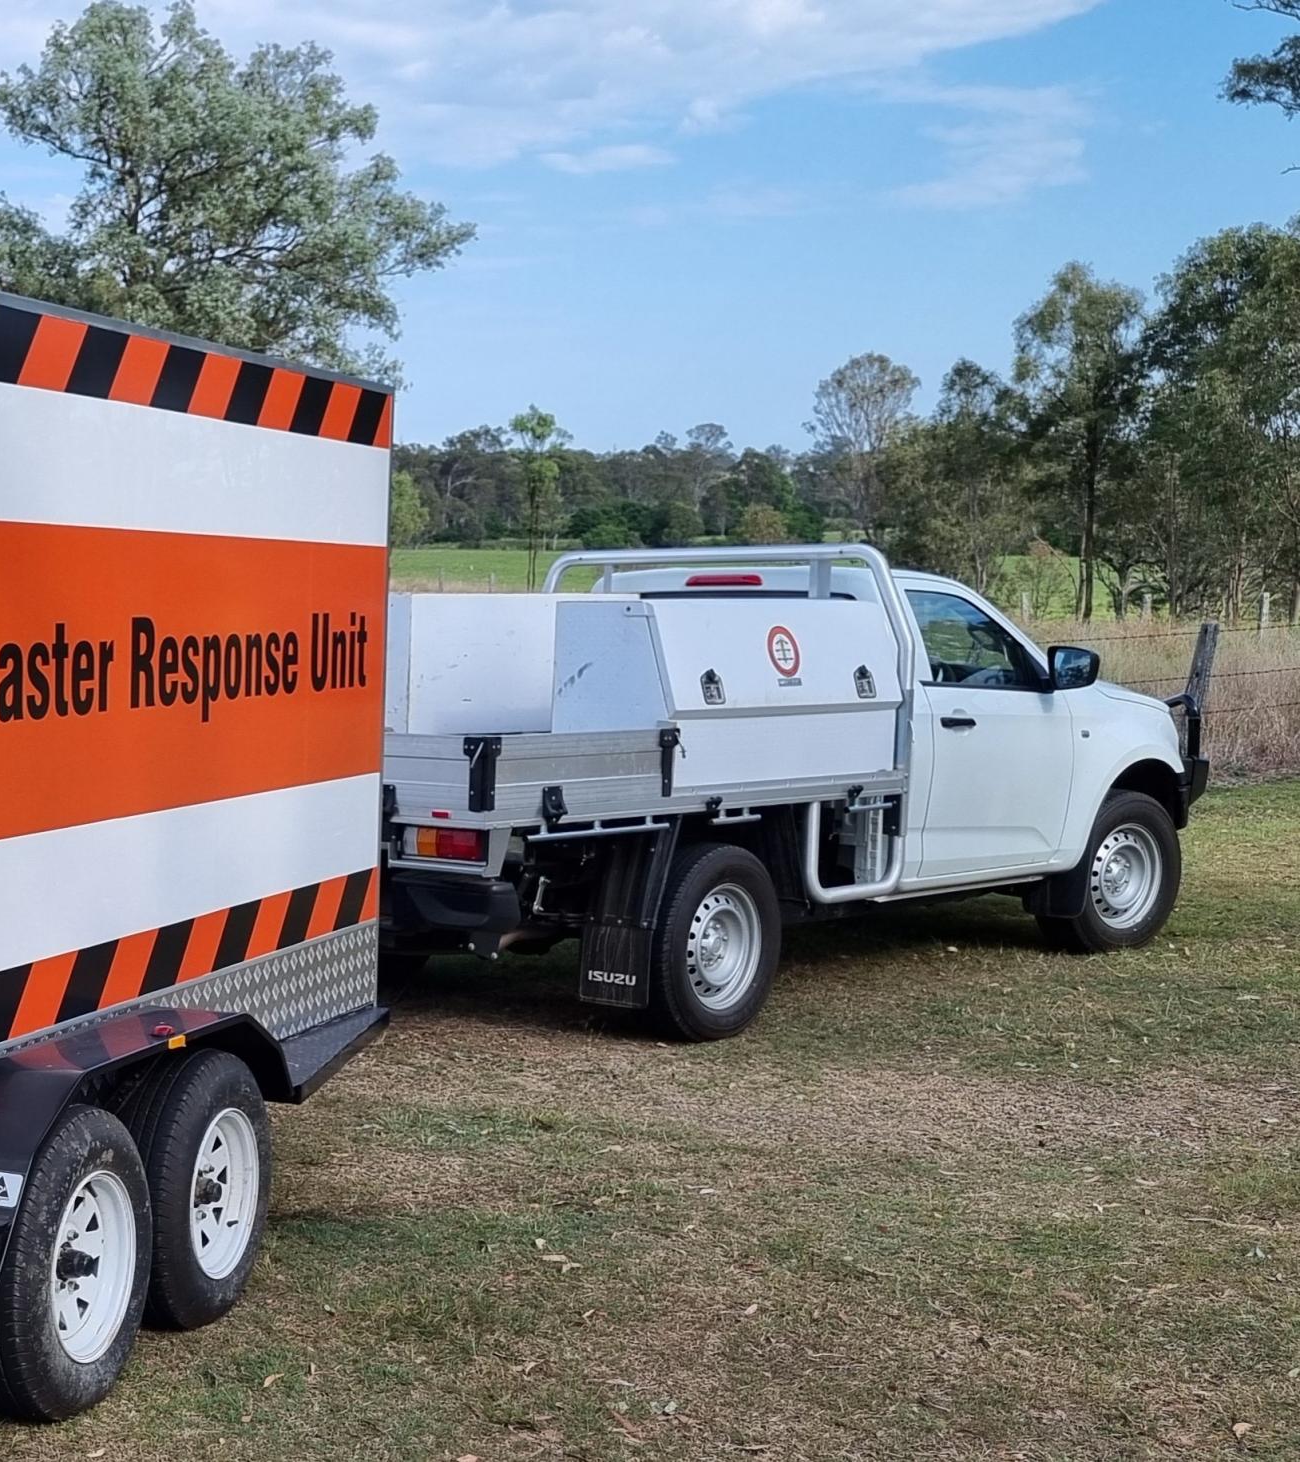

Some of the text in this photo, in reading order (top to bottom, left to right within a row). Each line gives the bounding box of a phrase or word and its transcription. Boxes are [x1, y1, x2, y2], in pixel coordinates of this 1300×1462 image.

[130, 615, 299, 724] Response
[310, 611, 368, 694] Unit
[588, 970, 636, 986] ISUZU
